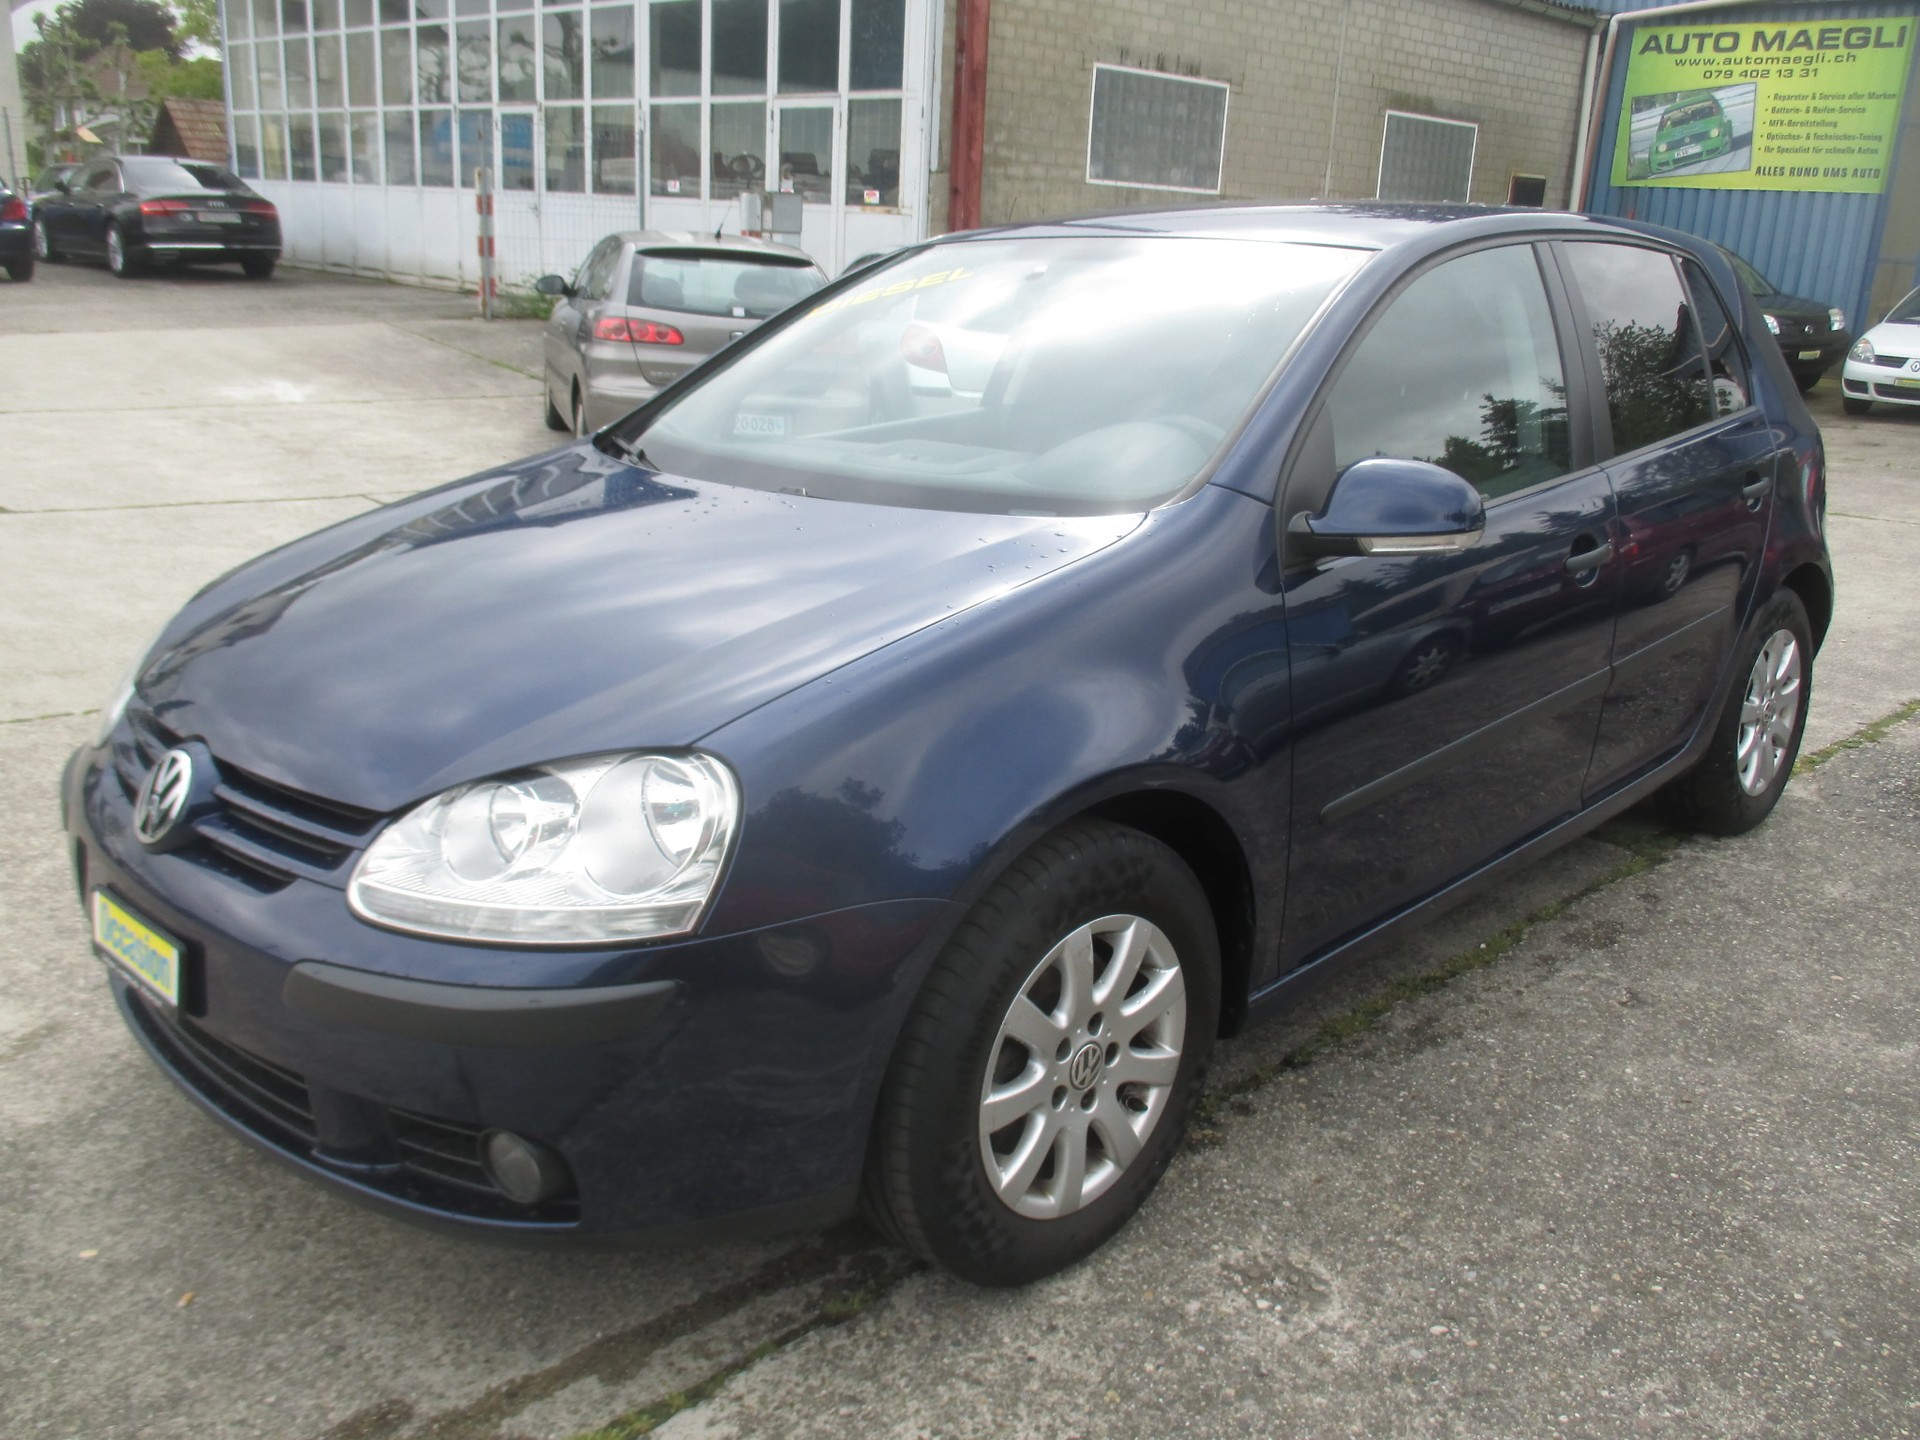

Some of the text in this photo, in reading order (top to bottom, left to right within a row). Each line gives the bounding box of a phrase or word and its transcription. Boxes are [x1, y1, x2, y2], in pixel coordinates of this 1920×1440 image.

[1639, 25, 1907, 55] AUTO MAEGLI
[1675, 52, 1856, 67] www.automaegli.ch
[1703, 68, 1818, 79] 079 402 13 31
[1818, 92, 1846, 100] Service
[1755, 166, 1881, 179] ALLES RUND UMS AUTO
